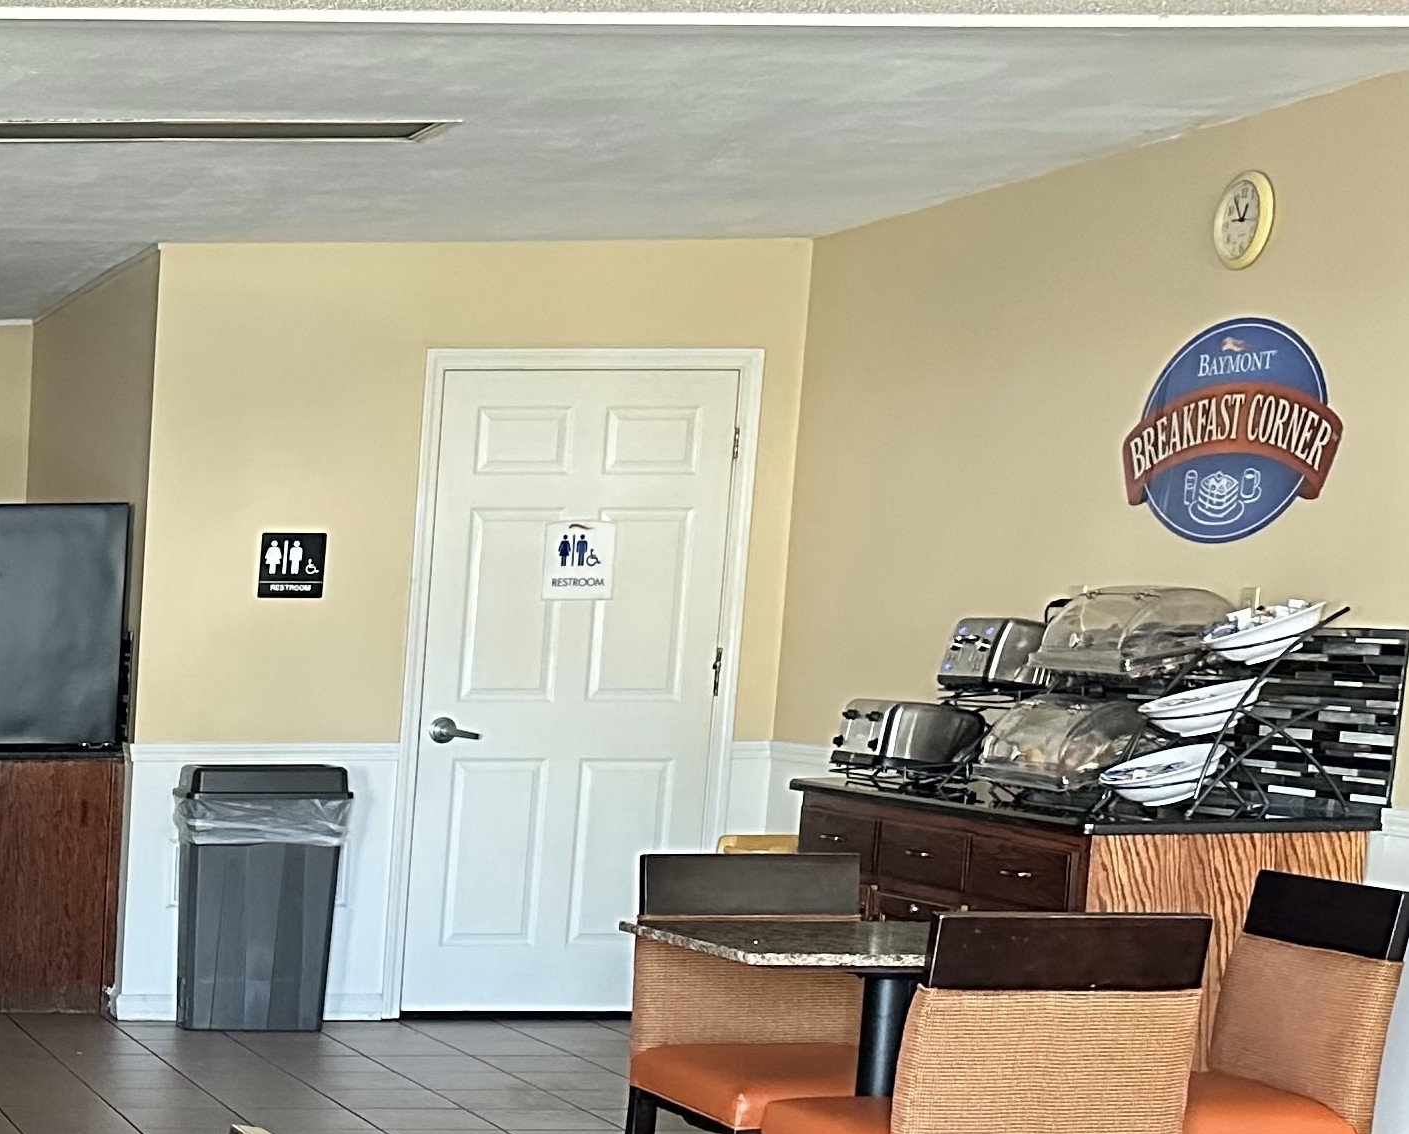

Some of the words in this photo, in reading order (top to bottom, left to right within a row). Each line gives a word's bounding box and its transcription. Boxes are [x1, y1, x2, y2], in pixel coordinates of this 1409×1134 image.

[1197, 350, 1277, 377] BAYMONT
[1130, 393, 1245, 479] BREAKFAST
[1247, 393, 1332, 471] CORNER
[551, 577, 604, 587] RESTROOM
